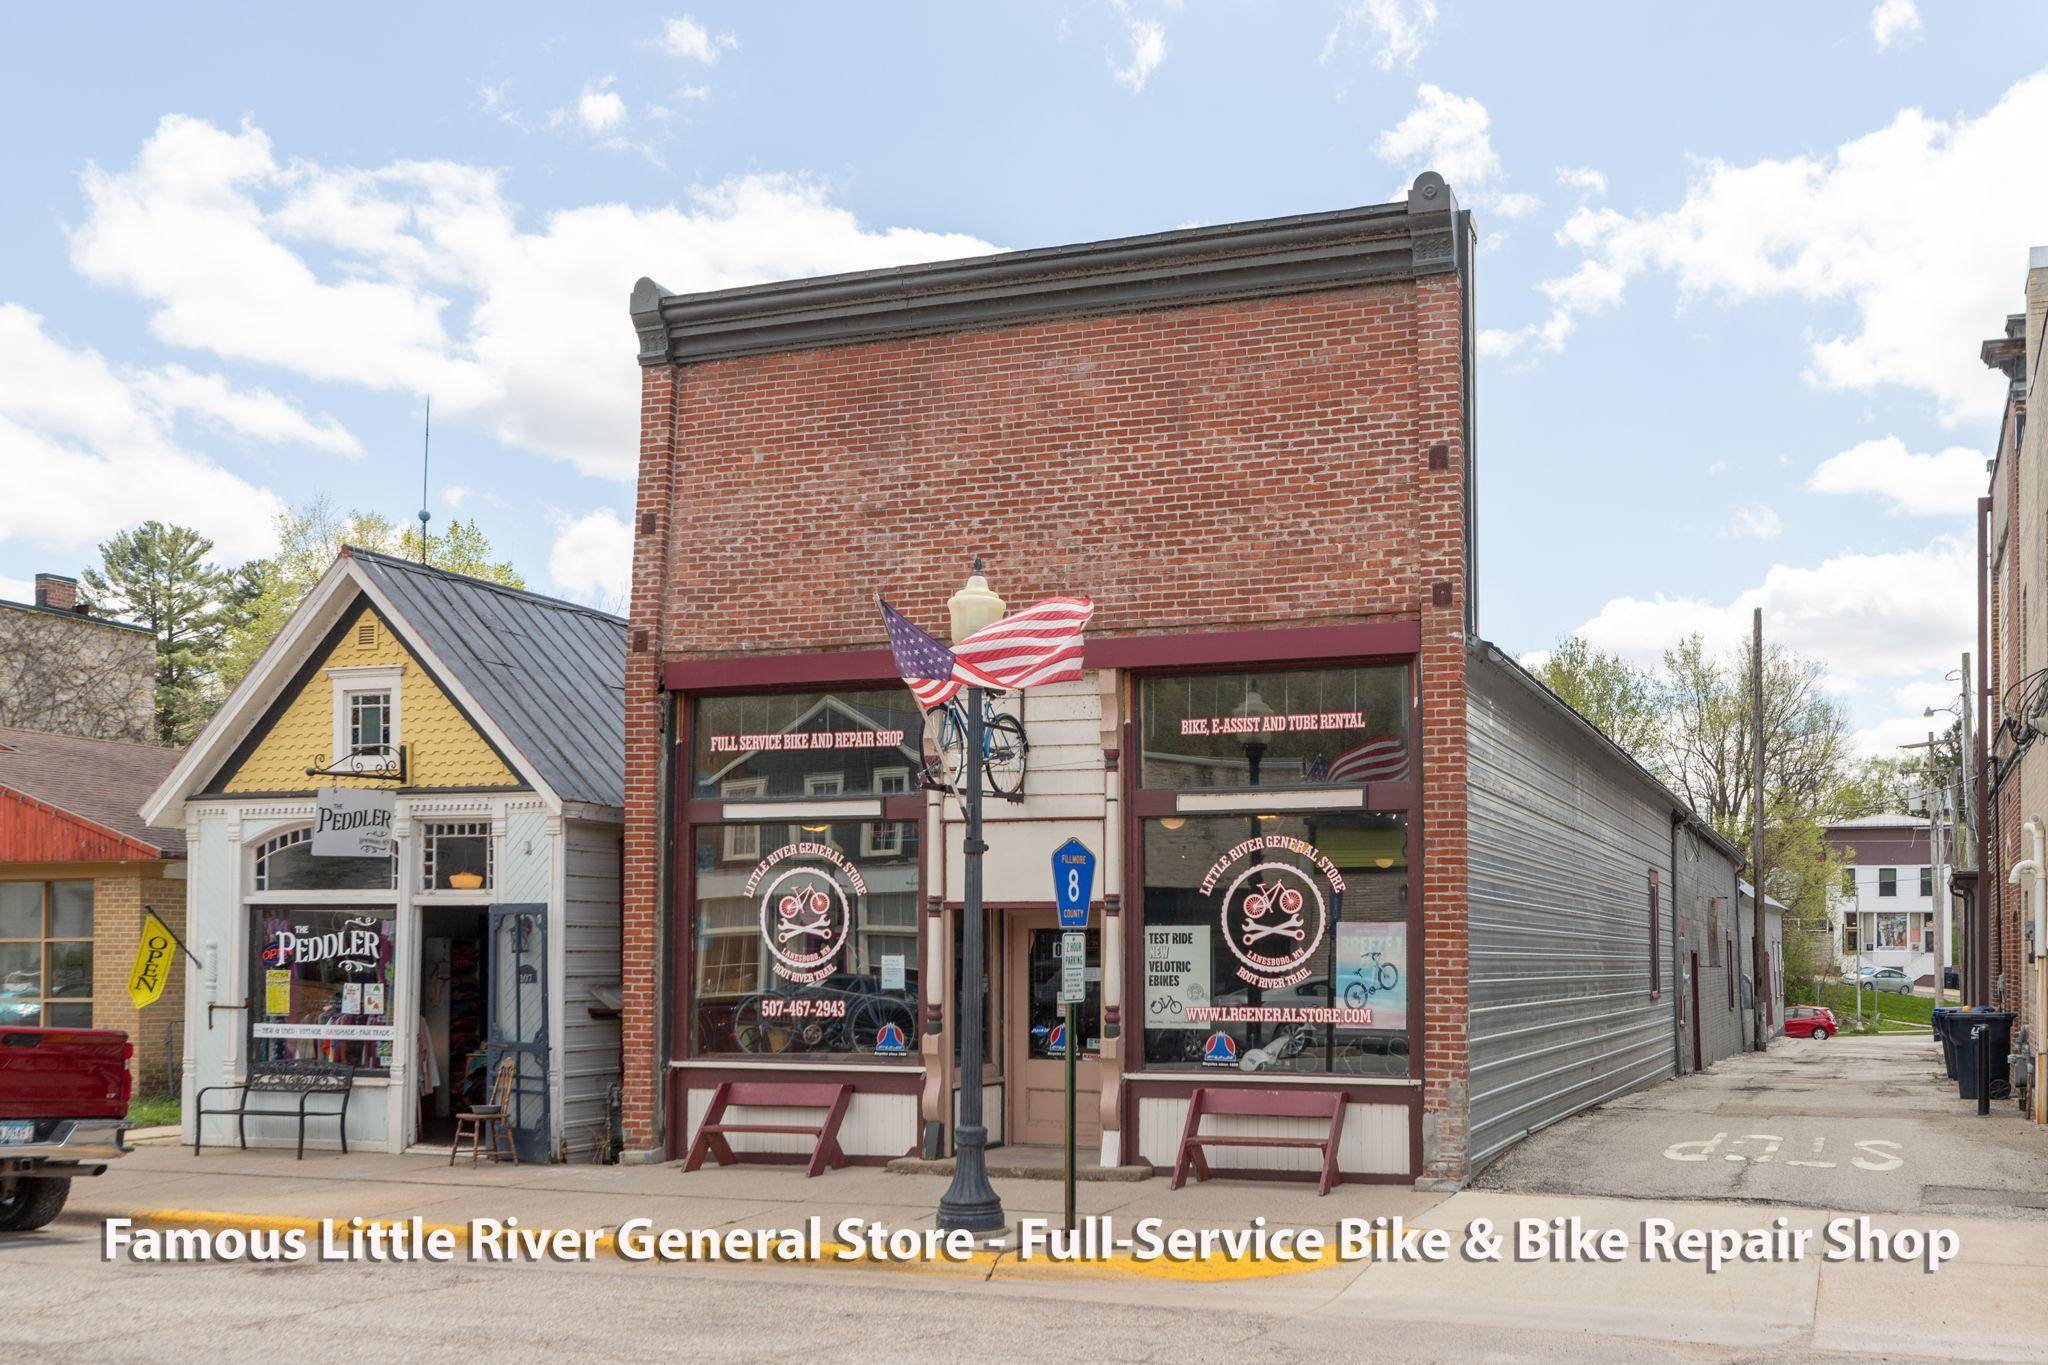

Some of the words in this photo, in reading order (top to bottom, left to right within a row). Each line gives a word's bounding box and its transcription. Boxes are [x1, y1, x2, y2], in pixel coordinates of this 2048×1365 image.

[1180, 718, 1210, 736] BIKE,
[1211, 716, 1260, 734] E-ASSIST
[1262, 715, 1287, 732] AND
[1287, 713, 1319, 731] TUBE
[1320, 711, 1365, 730] RENTAL
[710, 735, 738, 752] FULL
[739, 734, 783, 751] SERVICE
[783, 733, 810, 750] BIKE
[810, 732, 834, 749] AND
[834, 730, 875, 748] REPAIR
[876, 730, 904, 747] SHOP
[316, 806, 391, 833] PEDDLER
[1061, 855, 1087, 865] FILLMORE
[1199, 855, 1232, 897] LITTLE
[1228, 837, 1265, 862] RIVER
[1266, 835, 1319, 862] GENERAL
[1317, 856, 1347, 894] STORE
[743, 859, 770, 898] LITTLE
[768, 843, 798, 866] RIVER
[799, 842, 845, 866] GENERAL
[842, 862, 868, 897] STORE
[1068, 868, 1079, 902] 8
[1063, 909, 1084, 918] COUNTY
[294, 925, 309, 934] THE
[1148, 932, 1170, 944] TEST
[1172, 932, 1193, 944] RIDE
[275, 930, 380, 966] PEDDLER
[1066, 942, 1070, 952] 2
[1070, 942, 1082, 953] HOUR
[1149, 945, 1170, 959] NEW
[133, 936, 168, 993] OPEN
[1065, 955, 1083, 966] PARKING
[1148, 961, 1191, 973] VELOTRIC
[772, 962, 791, 980] ROOT
[790, 971, 815, 983] RIVER
[814, 963, 838, 981] TRAIL
[1148, 975, 1180, 987] EBIKES
[1236, 966, 1258, 985] ROOT
[1257, 977, 1286, 989] RIVER
[1284, 966, 1312, 985] TRAIL
[761, 1000, 846, 1018] 507-467-2943
[1185, 1007, 1372, 1024] WWW.LRGENERALSTORE.COM
[1662, 1132, 1905, 1171] STOP
